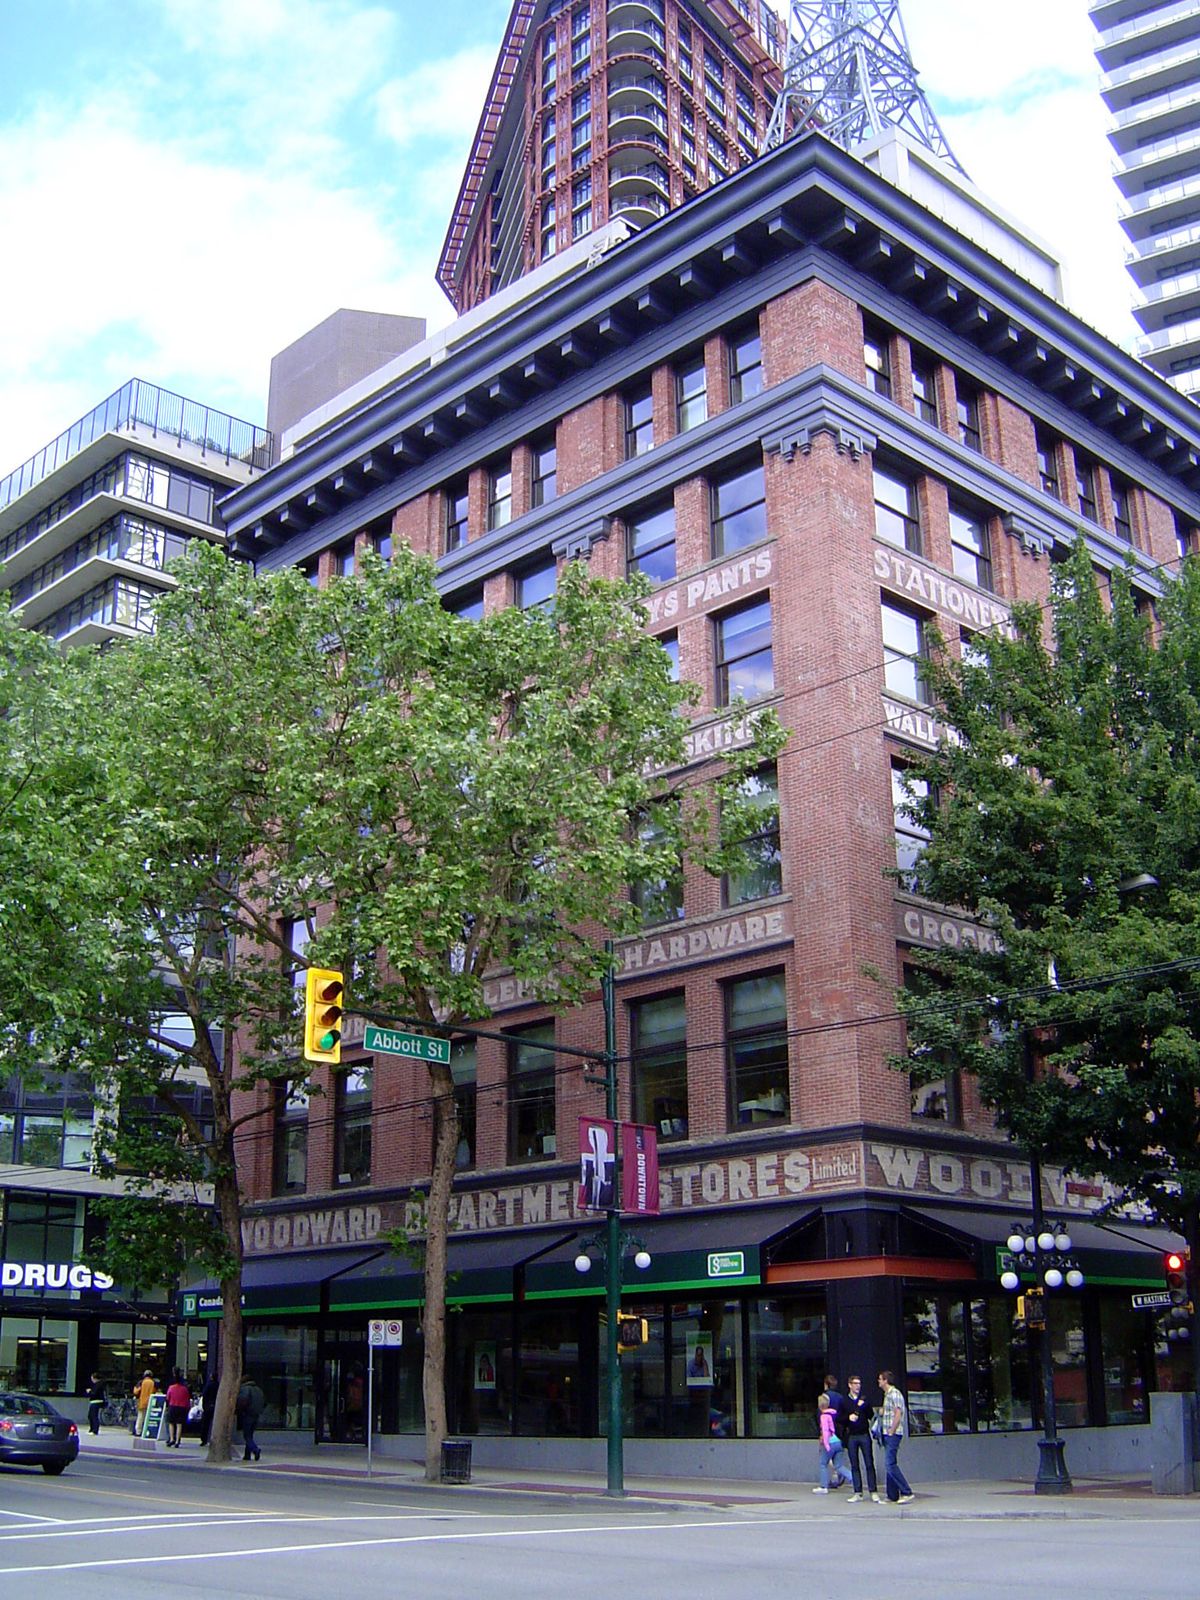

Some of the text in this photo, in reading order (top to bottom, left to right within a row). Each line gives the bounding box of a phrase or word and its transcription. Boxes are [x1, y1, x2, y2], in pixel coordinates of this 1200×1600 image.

[687, 550, 772, 608] PANTS
[883, 702, 940, 745] WALL
[624, 911, 784, 970] HARDWARE
[372, 1032, 422, 1054] Abbott
[427, 1041, 443, 1058] St
[637, 1153, 647, 1210] DOWNTOWN
[812, 1151, 857, 1180] Limited
[2, 1263, 114, 1289] DRUGS
